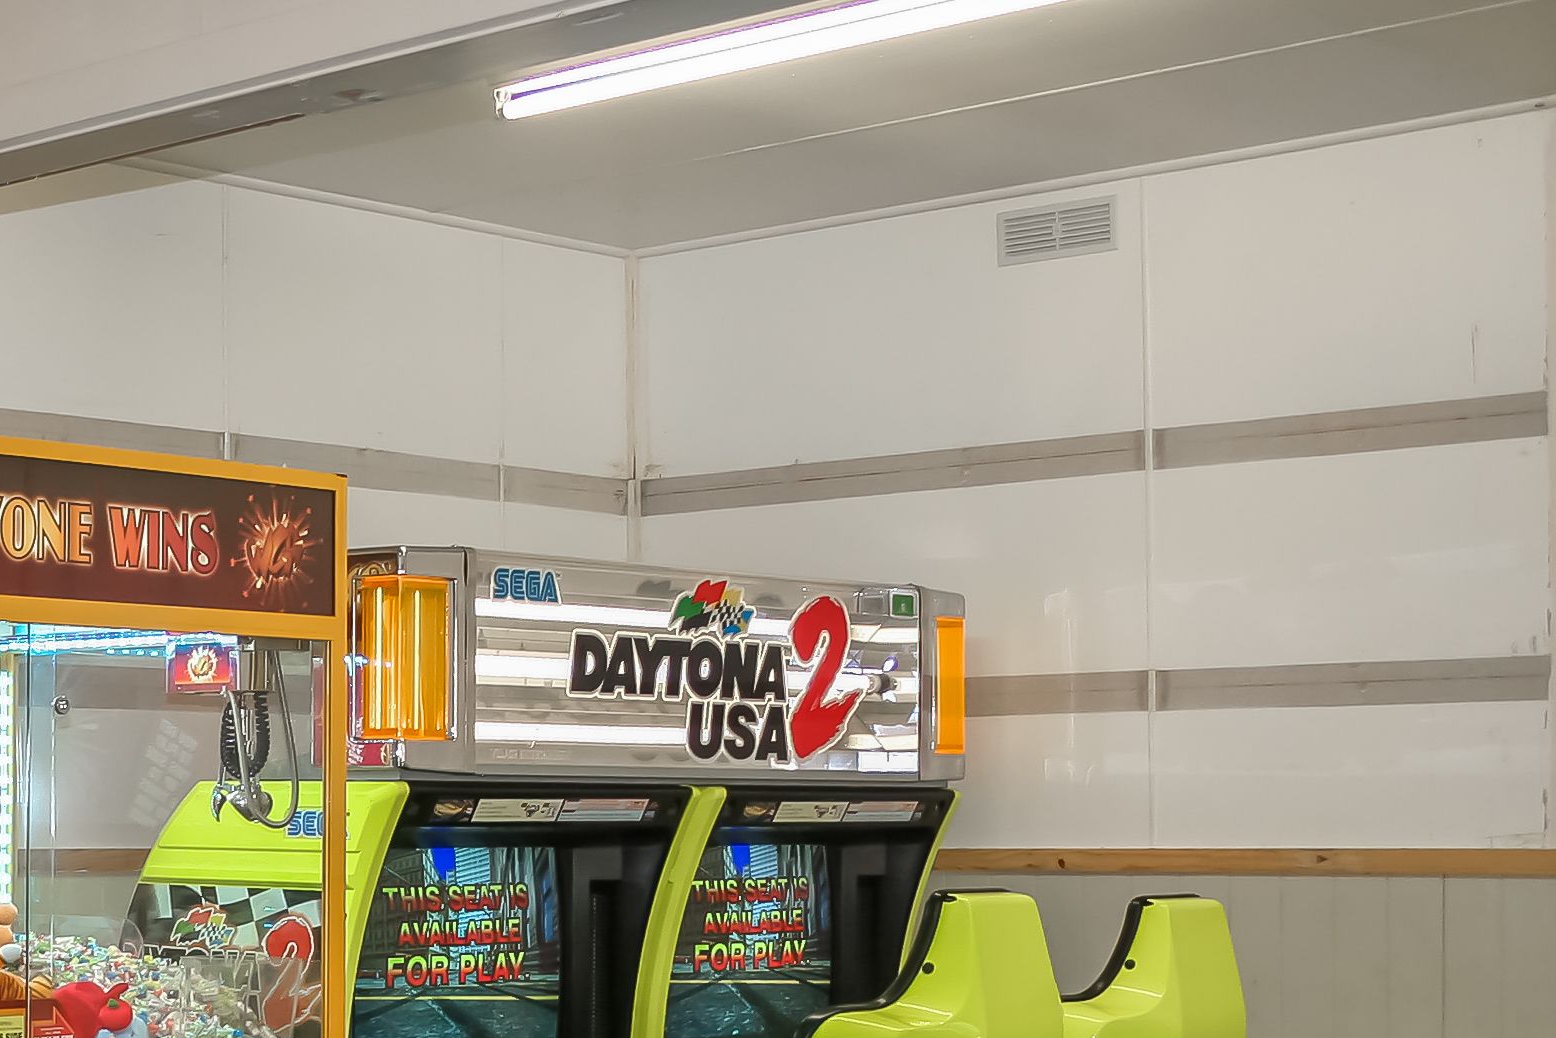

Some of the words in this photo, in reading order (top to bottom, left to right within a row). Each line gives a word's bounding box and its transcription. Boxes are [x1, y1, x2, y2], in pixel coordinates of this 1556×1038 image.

[108, 505, 218, 577] WINS
[492, 567, 560, 603] SEGA
[567, 628, 791, 703] DAYTONA
[789, 594, 870, 763] 2
[684, 698, 791, 763] USA
[382, 885, 440, 913] THIS
[447, 884, 503, 912] SEAT
[509, 882, 529, 910] IS
[691, 878, 739, 904] THIS
[744, 877, 788, 902] SEAT
[794, 876, 809, 901] IS
[397, 917, 523, 946] AVAILABLE
[702, 909, 806, 935] AVAILABLE
[385, 955, 450, 989] FOR
[694, 942, 746, 973] FOR
